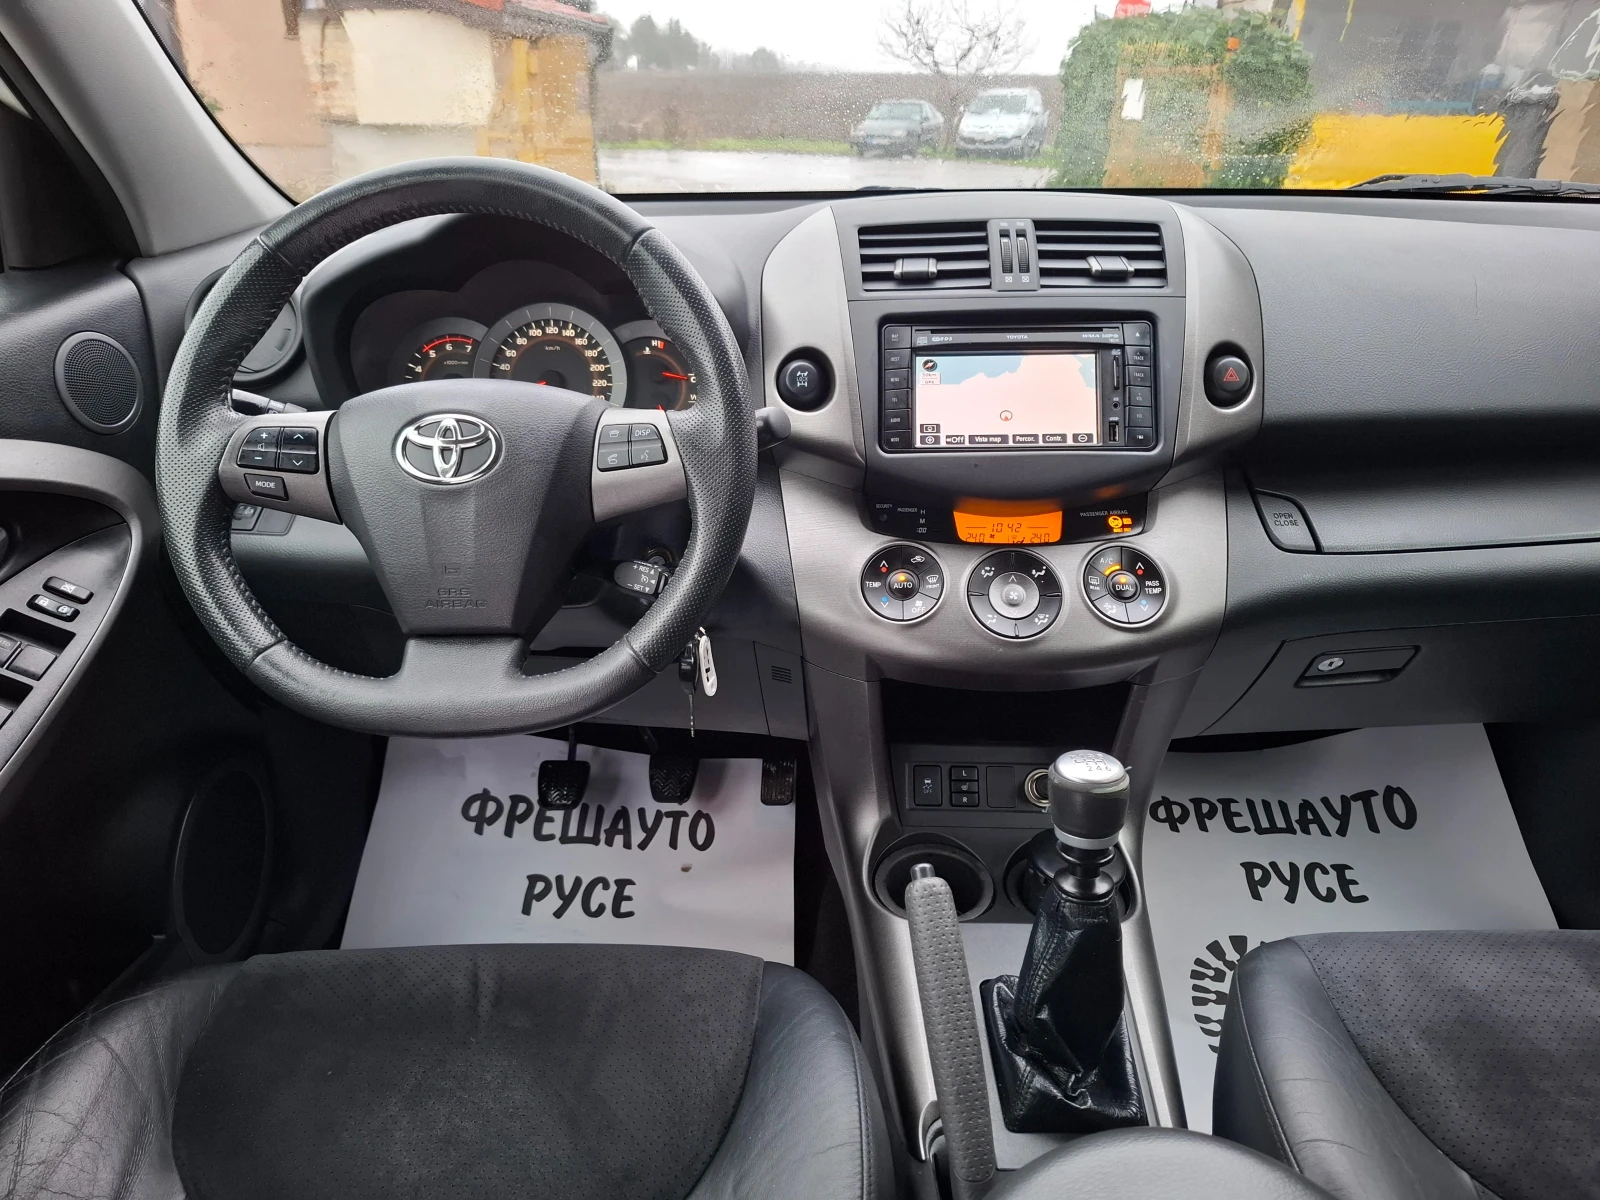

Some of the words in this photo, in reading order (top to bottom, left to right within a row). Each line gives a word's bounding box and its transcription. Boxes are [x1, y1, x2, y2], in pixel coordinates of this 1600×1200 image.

[255, 480, 276, 488] MODE
[638, 565, 650, 573] RES
[633, 583, 644, 591] SET
[438, 588, 470, 596] SRS
[425, 600, 488, 609] AIRBAG
[1148, 784, 1418, 838] ФРЕШАУТО
[461, 787, 716, 851] ФРЕШАУТО
[1239, 860, 1370, 904] РУСЕ
[521, 873, 637, 919] РУСЕ
